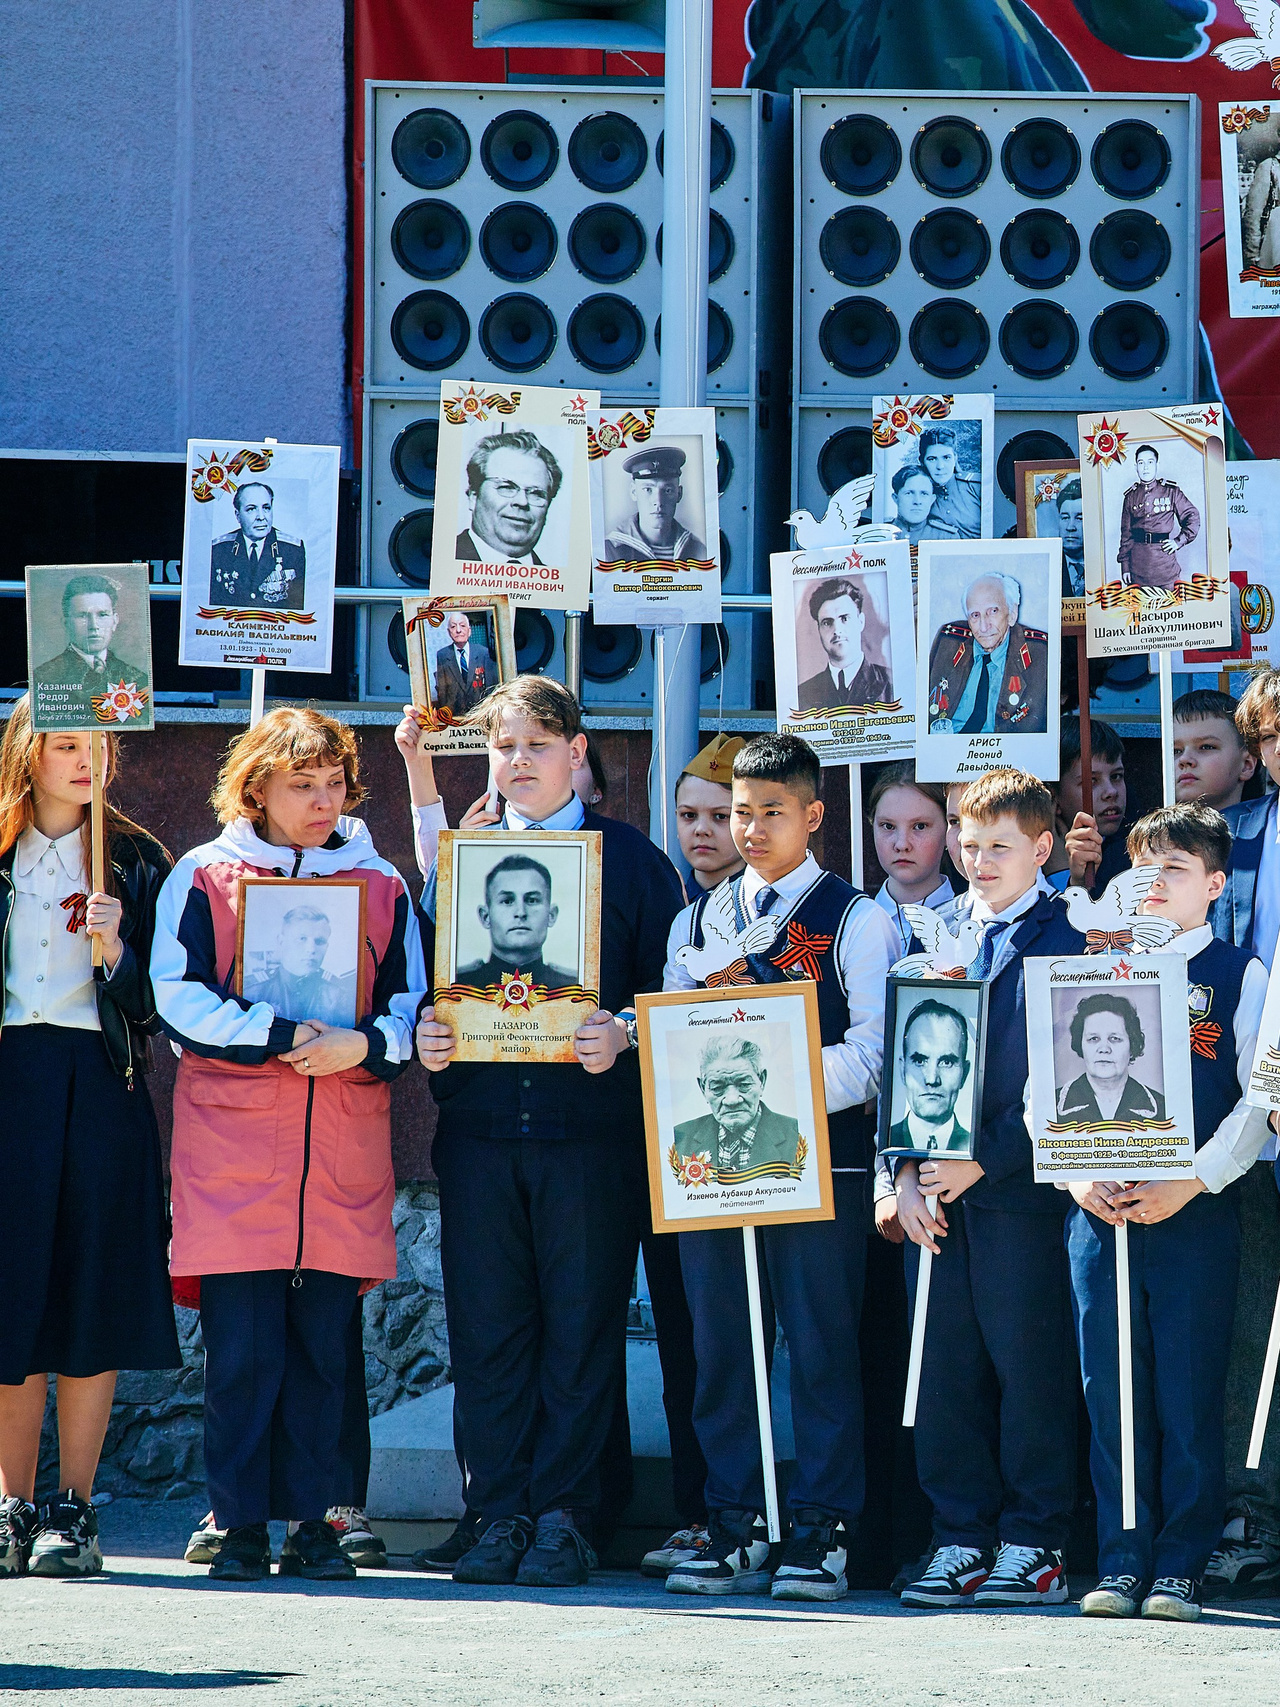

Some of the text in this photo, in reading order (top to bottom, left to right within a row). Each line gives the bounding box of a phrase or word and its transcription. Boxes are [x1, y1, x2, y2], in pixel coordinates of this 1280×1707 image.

[462, 562, 560, 581] НИКИФОРОВ
[456, 577, 565, 593] МИХАИЛ ИВАНОВИЧ
[642, 575, 673, 584] Шаргин
[613, 583, 702, 593] Виктор Иннокентьевич
[1132, 608, 1184, 624] Насыров
[228, 622, 285, 632] КЛИМЕНКО
[1094, 620, 1223, 639] Шаих Шайхуллинович
[195, 628, 317, 643] ВАСИЛИЙ ВАСИЛЬЕВИЧ
[1140, 634, 1177, 644] старшина
[1102, 638, 1215, 654] 35 механизированная бригада
[37, 682, 83, 693] Казанцев
[37, 692, 69, 703] Федор
[37, 702, 85, 712] Иванович
[782, 714, 916, 735] Лукьянов Иван Евгеньевич
[424, 740, 456, 752] Сергей
[969, 738, 1002, 747] АРИСТ
[966, 751, 1003, 760] Леонид
[956, 762, 1013, 774] Давыдович
[493, 1021, 540, 1031] НАЗАРОВ
[462, 1031, 572, 1044] Григорий Феоктистович
[501, 1045, 531, 1056] майор
[1038, 1135, 1189, 1149] Яковлева Нина Андреевна
[1057, 1148, 1176, 1161] февраля 1925 19 ноября 2011
[1043, 1162, 1061, 1171] годы
[1062, 1162, 1084, 1170] войны
[1155, 1159, 1193, 1168] медсестра
[686, 1186, 797, 1202] Изкенов Аубакир Аккулович
[720, 1199, 765, 1209] лейтенант
